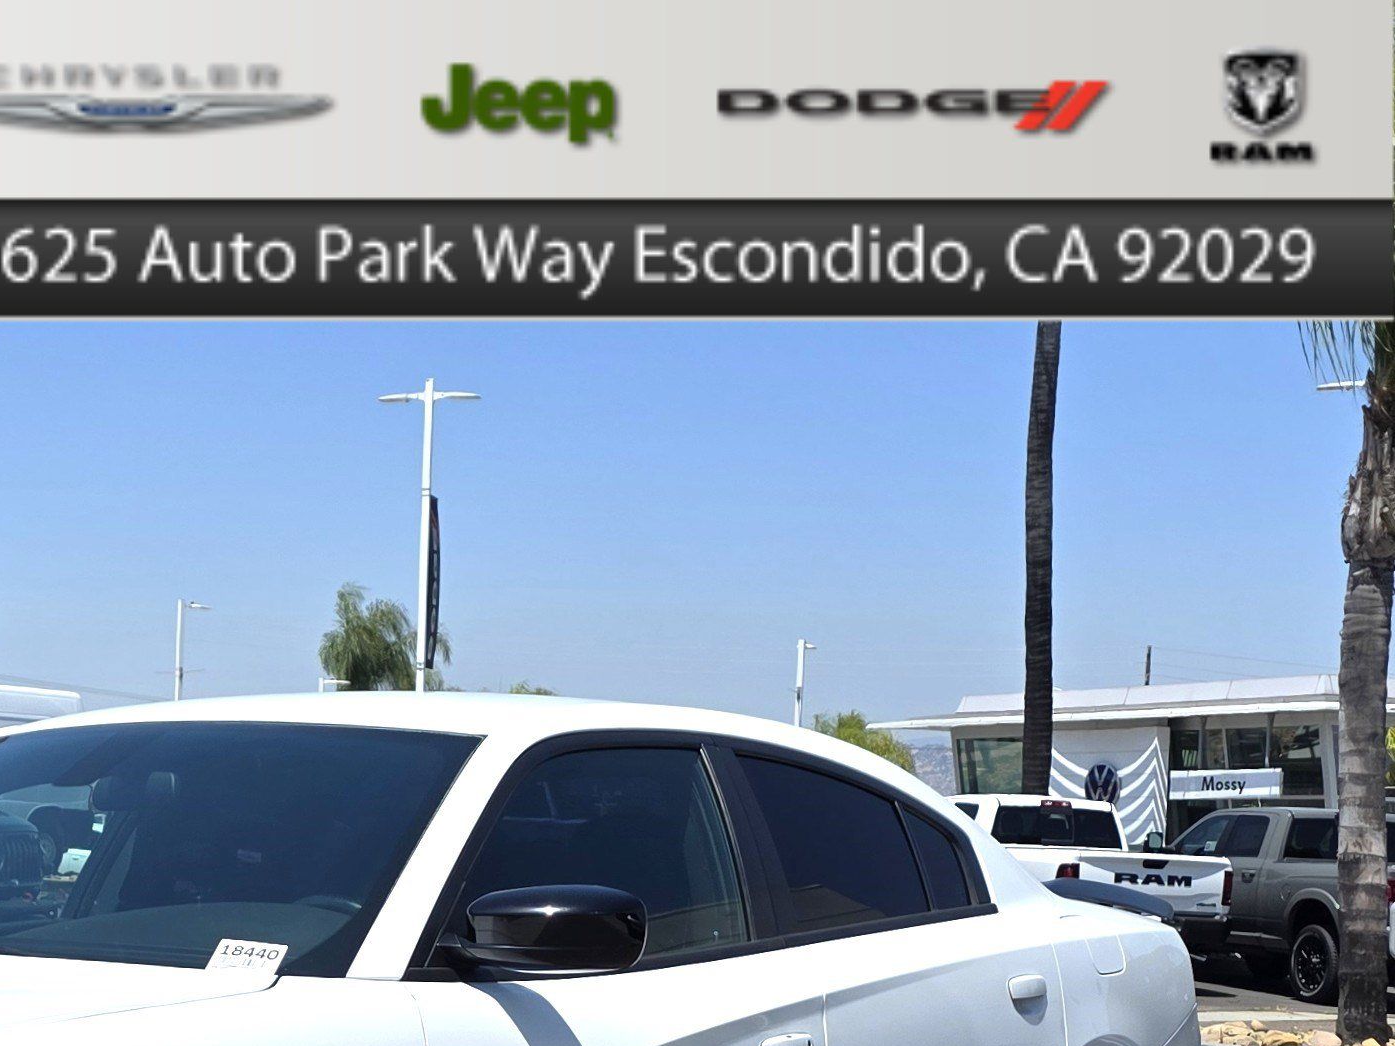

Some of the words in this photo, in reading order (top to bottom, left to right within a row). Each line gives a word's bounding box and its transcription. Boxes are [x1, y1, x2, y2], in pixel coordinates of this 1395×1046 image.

[1201, 776, 1246, 794] Mossy
[1114, 873, 1192, 887] RAM
[221, 945, 279, 960] 18440
